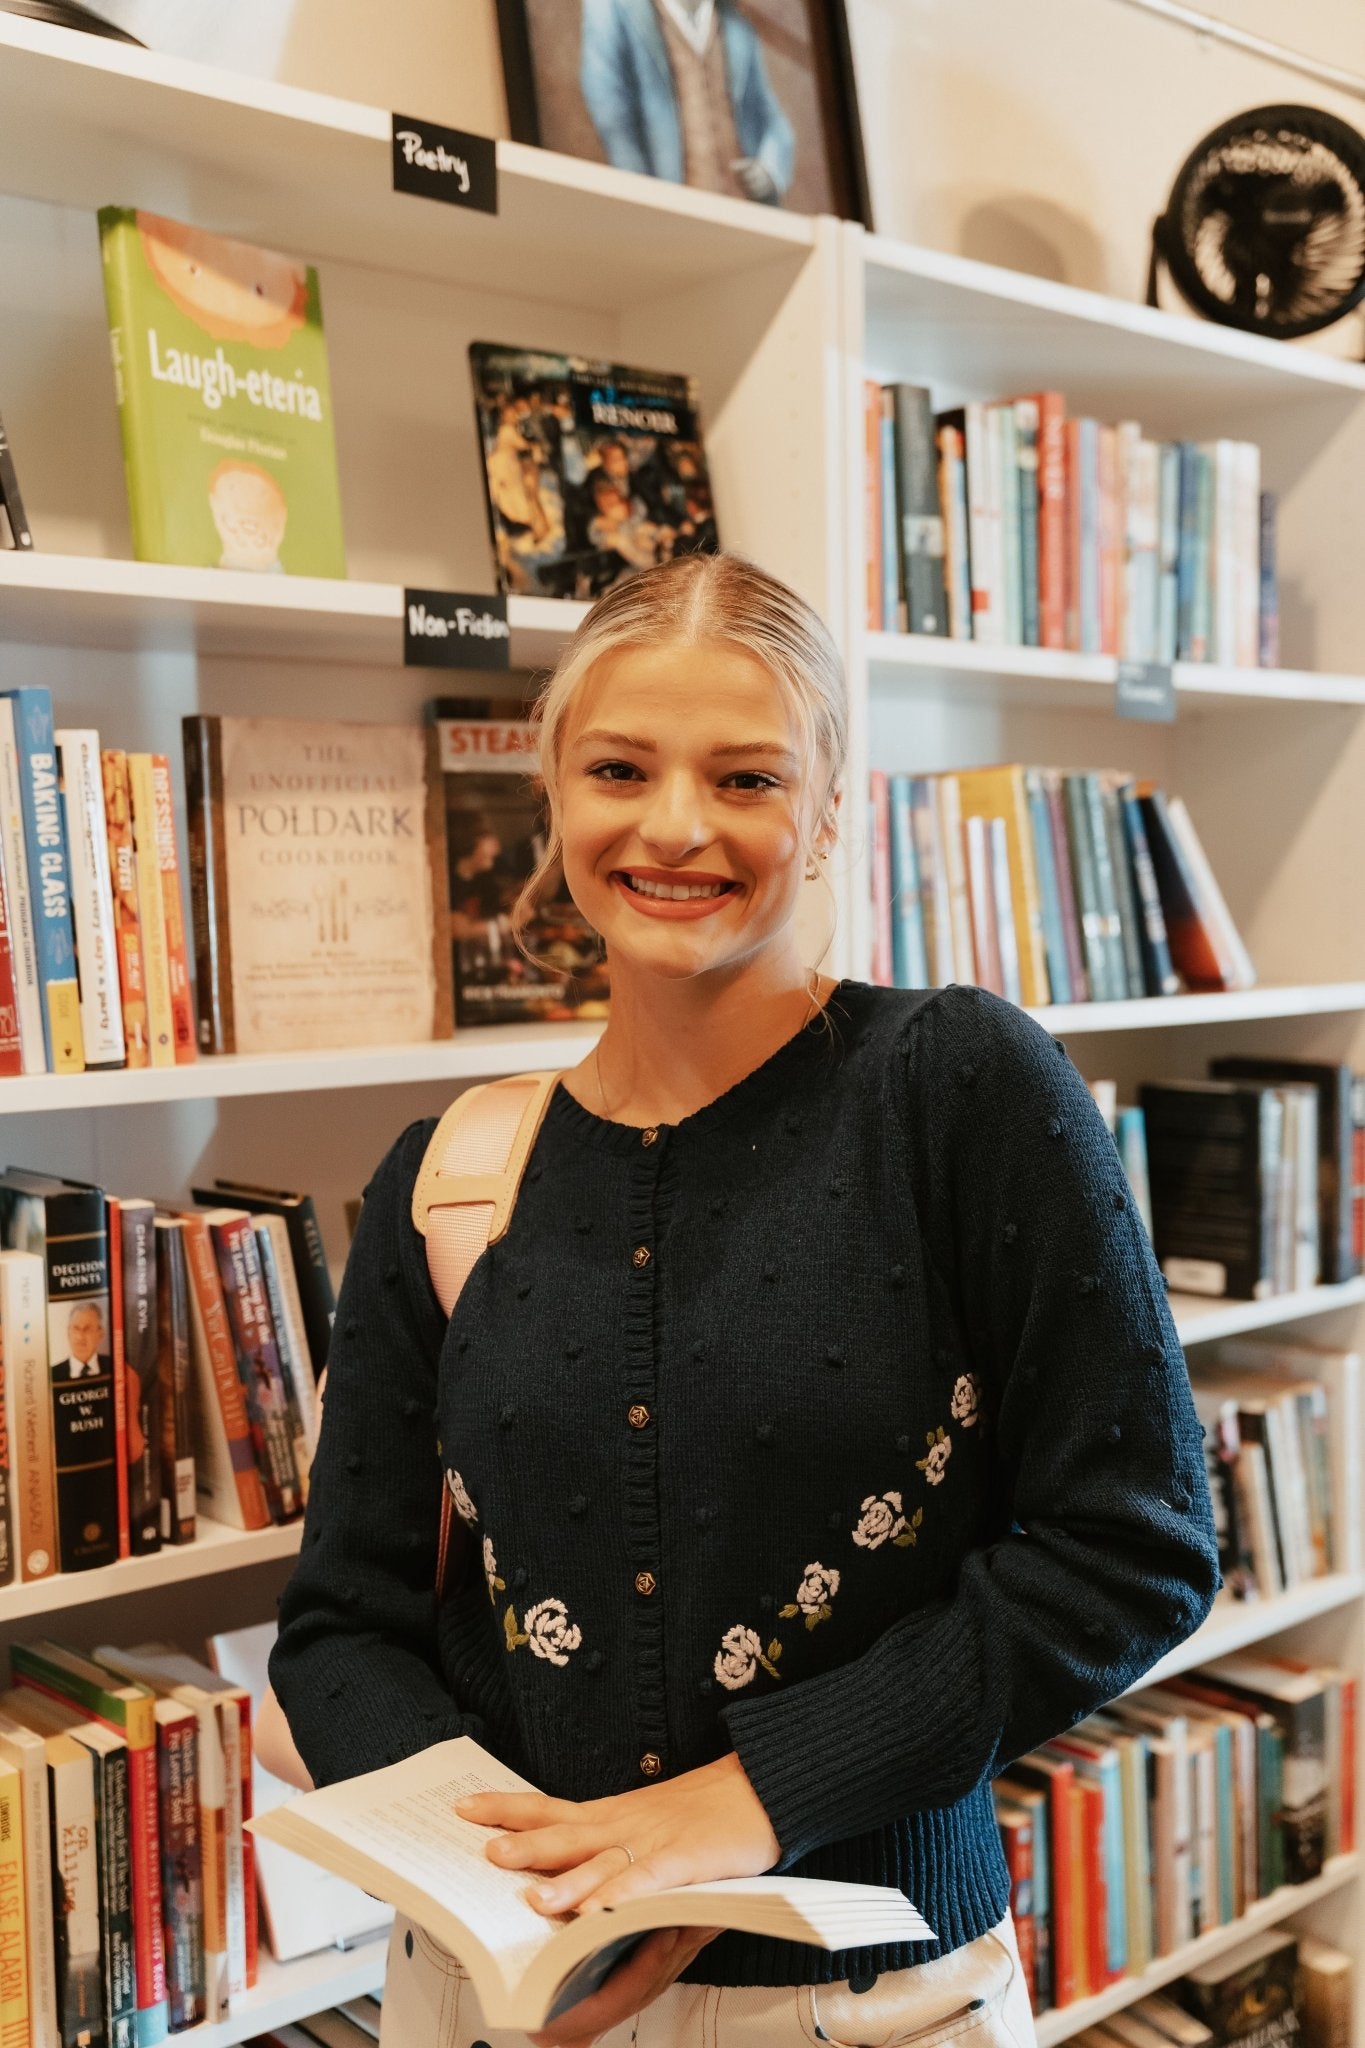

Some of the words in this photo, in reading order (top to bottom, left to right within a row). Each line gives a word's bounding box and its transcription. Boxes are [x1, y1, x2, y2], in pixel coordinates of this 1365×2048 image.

[396, 131, 470, 193] Poetry
[148, 328, 323, 422] Laugh-eteria
[302, 745, 349, 763] THE
[30, 753, 60, 847] BAKING
[250, 774, 399, 792] UNOFFICIAL
[238, 804, 415, 838] POLDARK
[258, 849, 399, 866] COOKBOOK
[39, 851, 67, 919] CLASS
[52, 1260, 106, 1277] DECISION
[59, 1273, 102, 1289] POINTS
[138, 1298, 148, 1334] EVIL
[58, 1386, 110, 1406] GEORGE
[69, 1417, 104, 1434] BUSH
[28, 1468, 44, 1535] ANASAZI
[78, 1825, 89, 1850] on
[63, 1824, 79, 1913] killing
[0, 1860, 20, 1917] FALSE
[0, 1930, 22, 2004] ALARM
